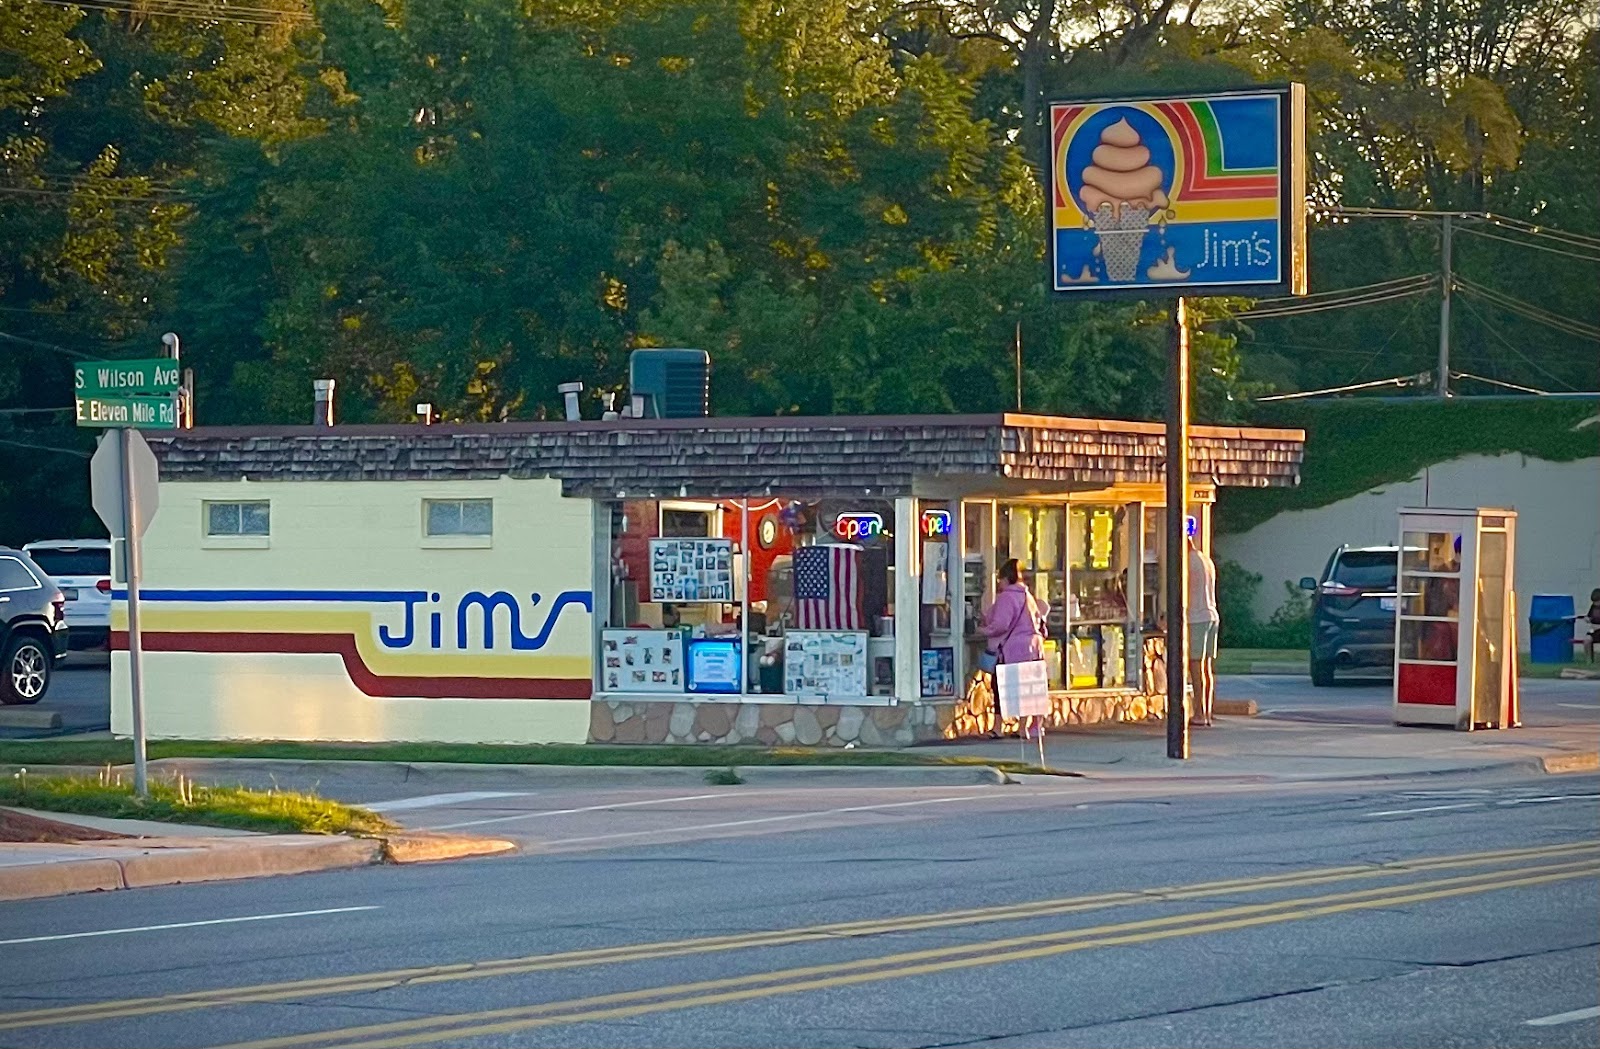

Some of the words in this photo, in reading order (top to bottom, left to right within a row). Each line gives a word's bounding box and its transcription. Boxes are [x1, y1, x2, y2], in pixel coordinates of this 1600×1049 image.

[1196, 228, 1272, 269] Jim's
[97, 368, 145, 389] Wilson
[153, 365, 179, 386] Ave
[90, 400, 128, 422] Eleven
[132, 402, 155, 423] Mile
[159, 402, 174, 423] Rd
[379, 590, 593, 650] Jim's
